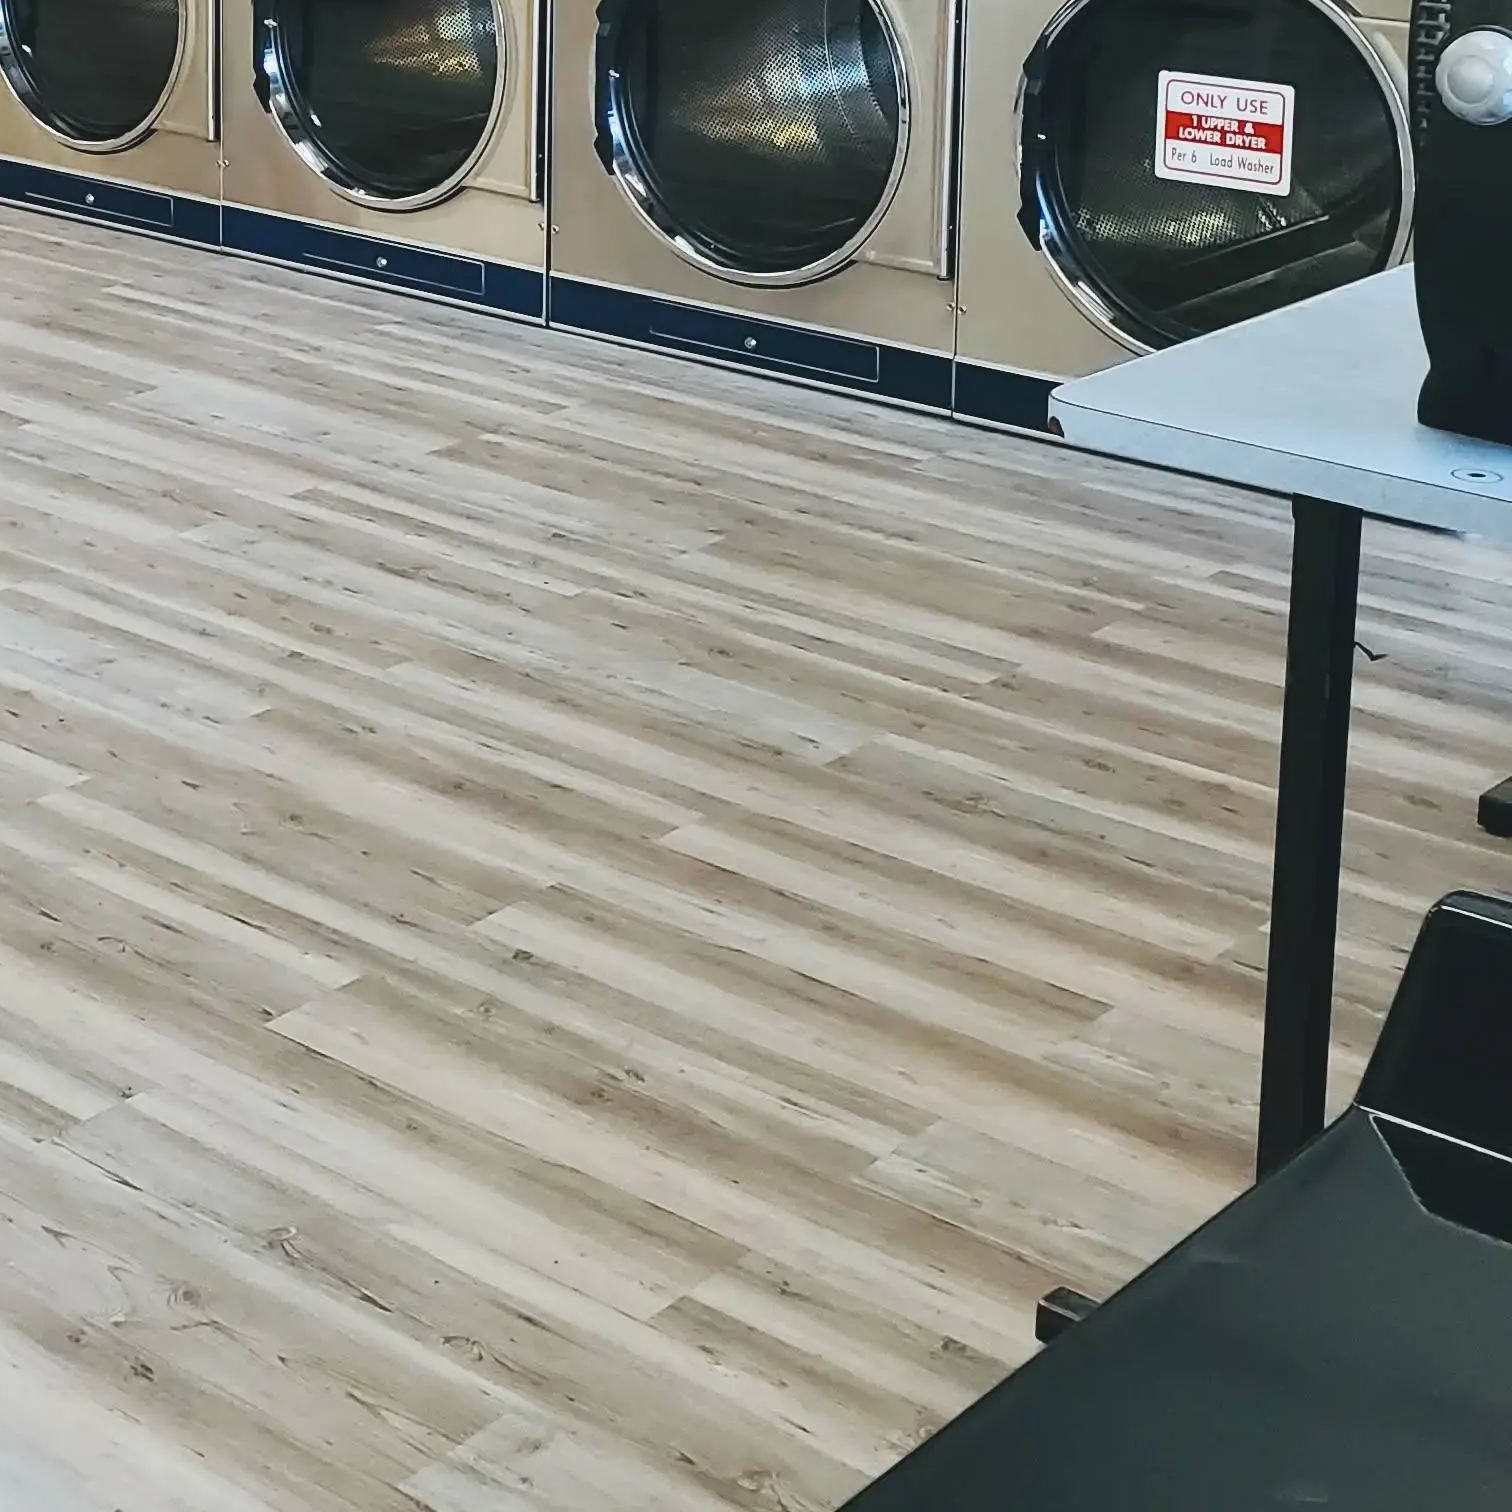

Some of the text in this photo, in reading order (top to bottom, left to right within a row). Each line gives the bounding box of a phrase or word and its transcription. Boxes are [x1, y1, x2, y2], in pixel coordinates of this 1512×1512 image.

[1180, 90, 1269, 116] ONLY USE
[1192, 115, 1255, 135] 1 UPPER &
[1178, 126, 1267, 150] LOWER DRYER
[1171, 147, 1275, 175] Per 6 Load Washer
